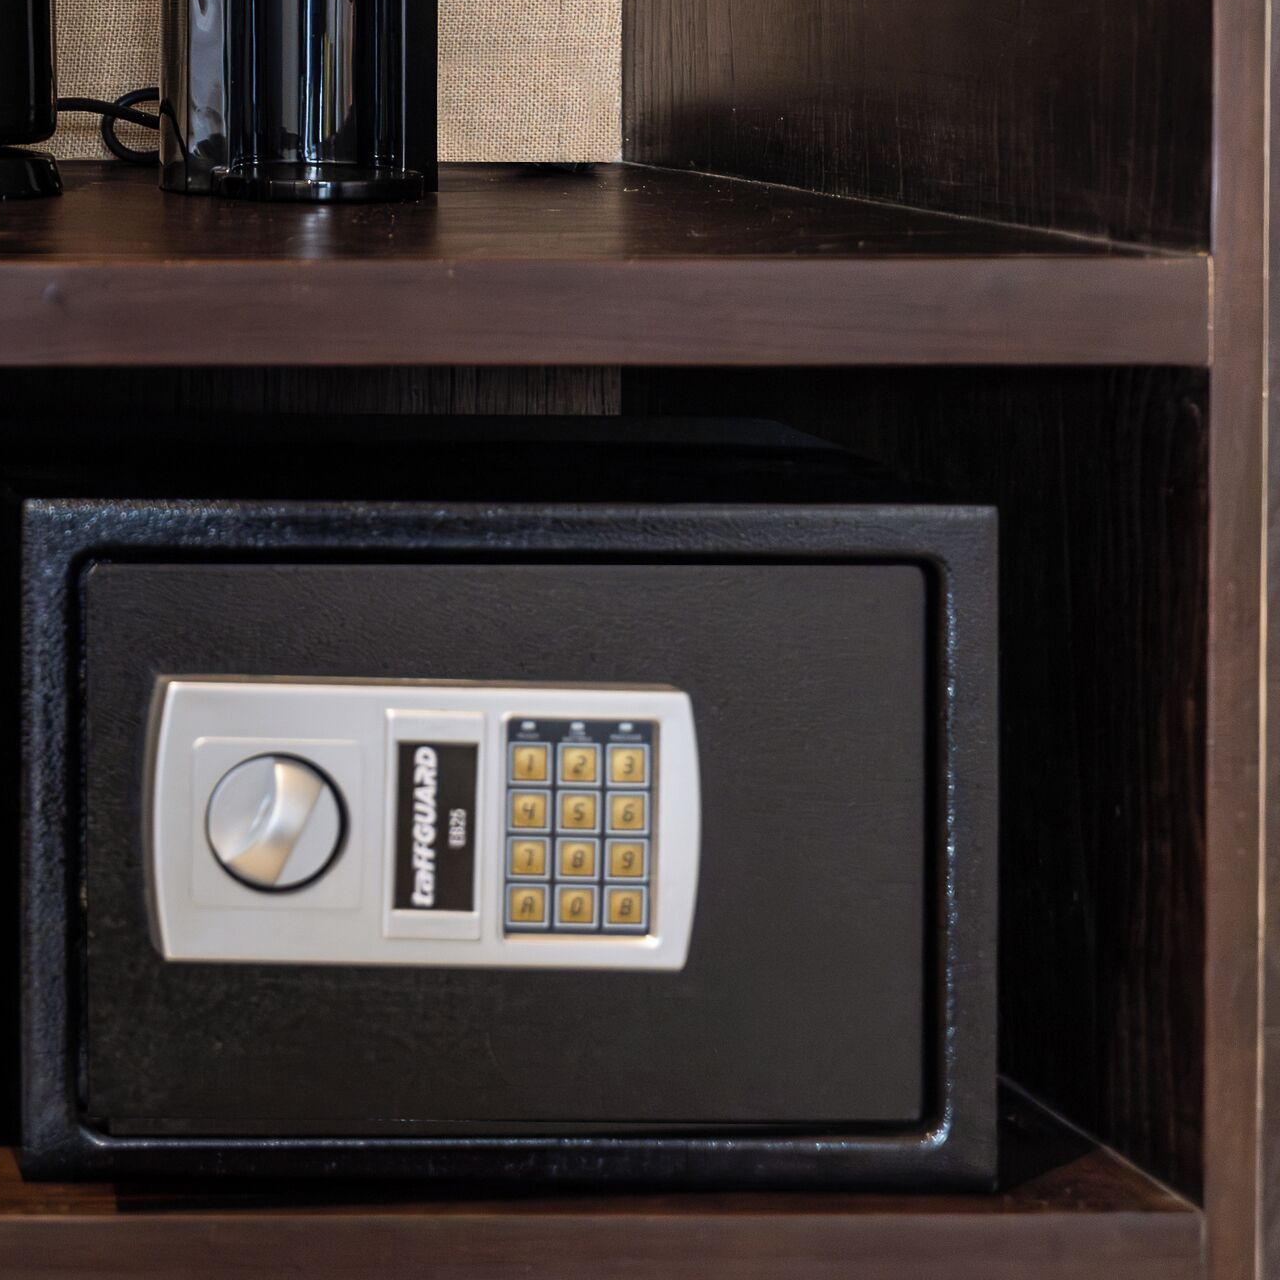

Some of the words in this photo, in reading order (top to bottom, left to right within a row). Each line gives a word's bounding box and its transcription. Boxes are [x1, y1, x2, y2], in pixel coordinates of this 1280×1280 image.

[526, 754, 535, 774] 1
[572, 755, 588, 775] 2
[622, 755, 636, 776] 3
[522, 802, 537, 821] 4
[573, 802, 587, 822] 5
[622, 803, 636, 823] 6
[523, 848, 535, 867] 7
[571, 849, 586, 869] 8
[621, 851, 635, 870] 9
[521, 896, 535, 915] A
[618, 898, 634, 917] B
